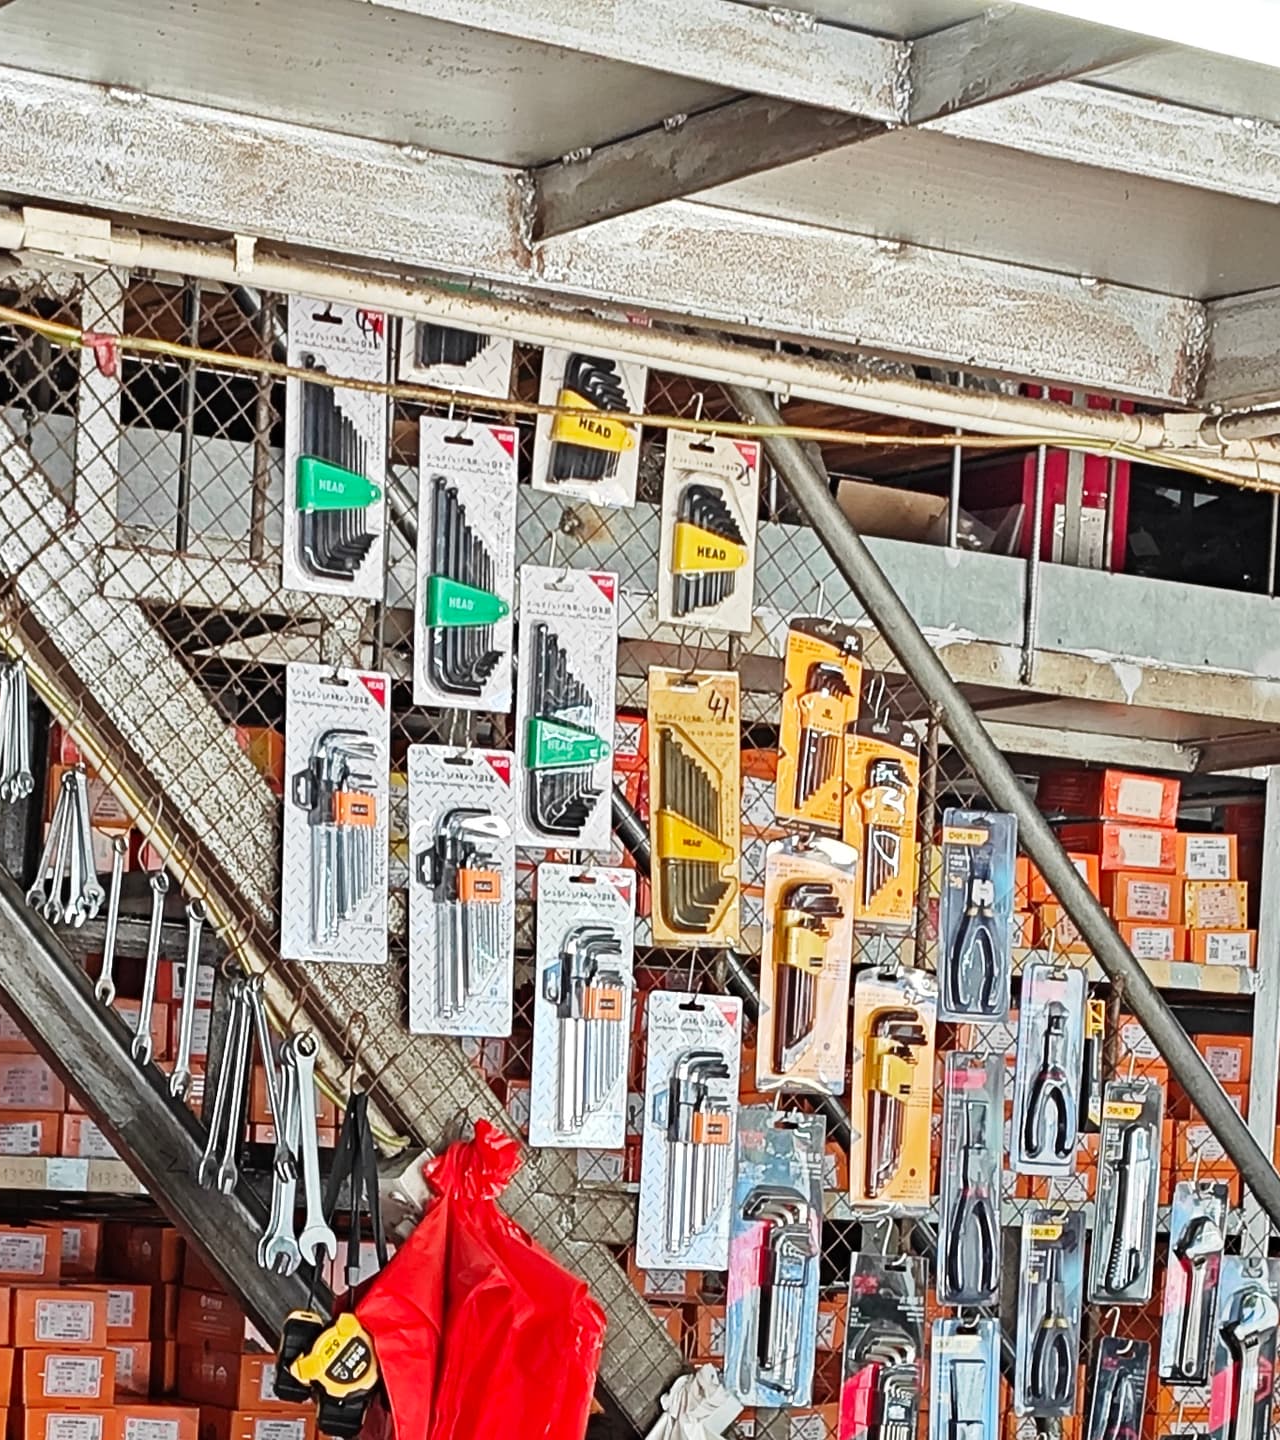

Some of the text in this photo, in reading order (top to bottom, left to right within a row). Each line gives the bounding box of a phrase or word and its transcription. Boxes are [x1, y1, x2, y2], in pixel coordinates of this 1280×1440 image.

[578, 418, 612, 440] HEAD
[318, 479, 345, 494] HEAD
[697, 545, 727, 560] HEAD
[449, 597, 474, 611] HEAD
